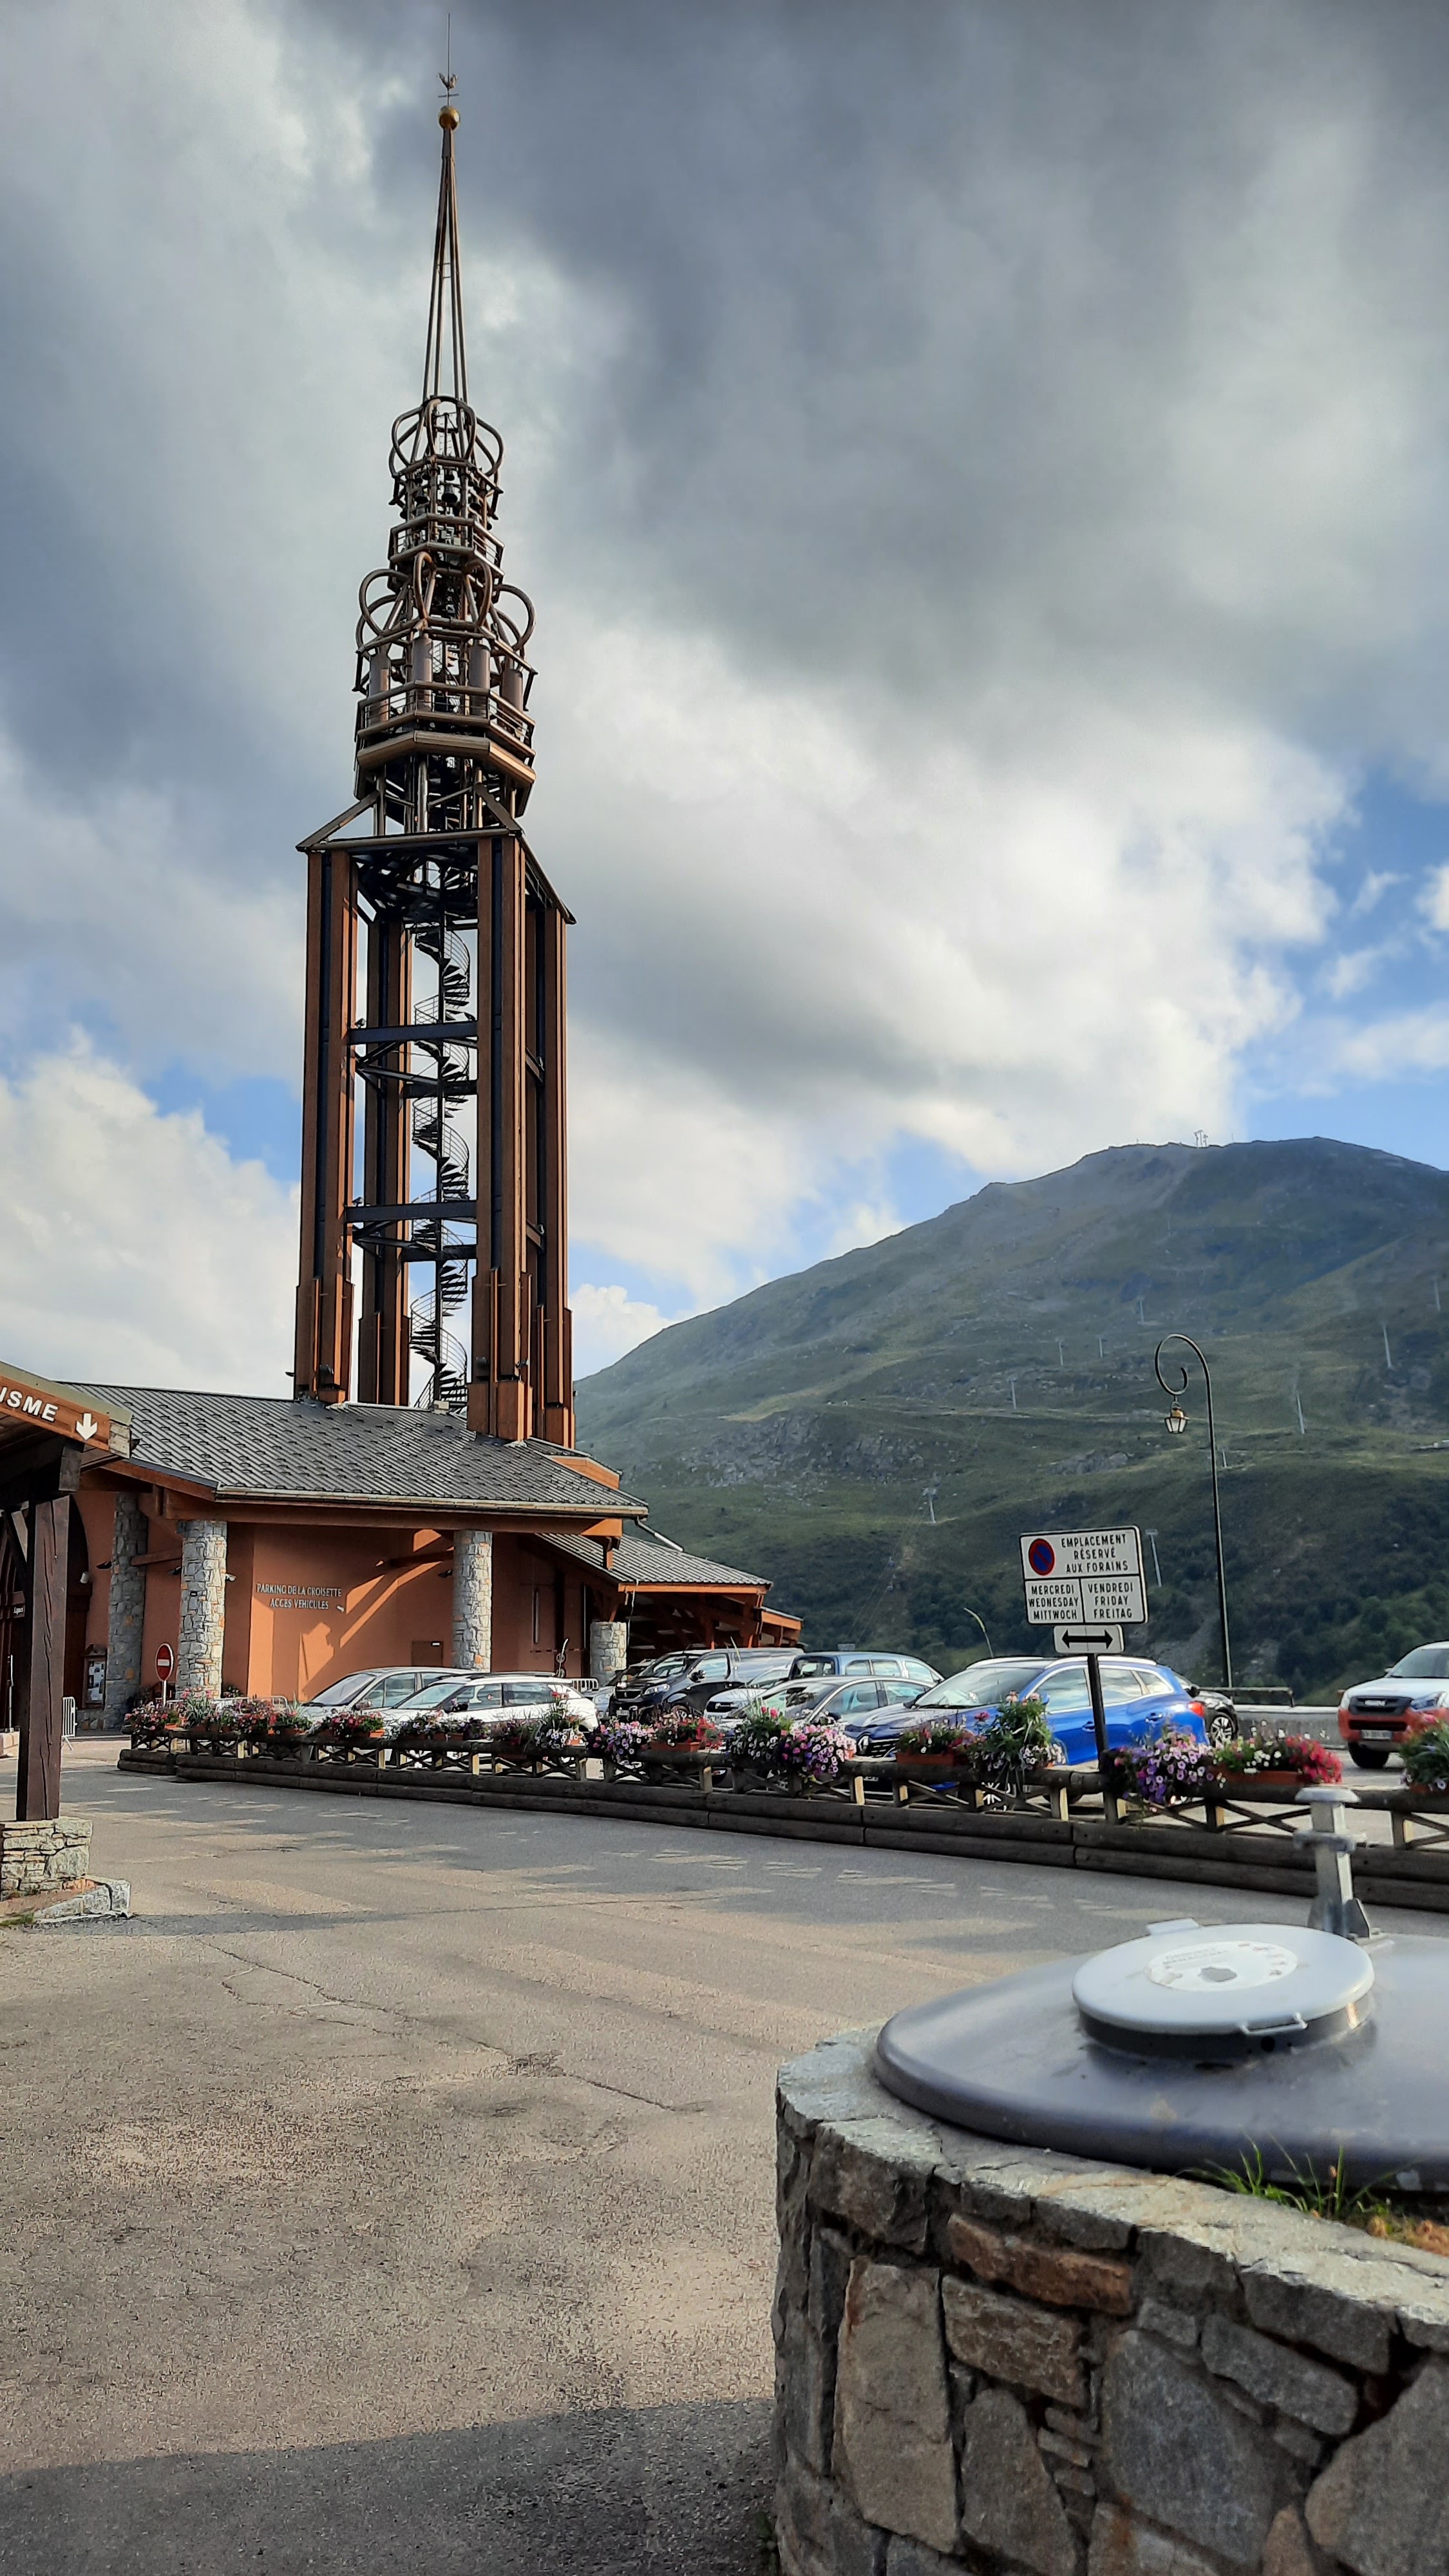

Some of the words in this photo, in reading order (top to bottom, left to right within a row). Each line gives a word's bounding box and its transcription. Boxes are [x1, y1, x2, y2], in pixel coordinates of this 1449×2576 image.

[1061, 1534, 1126, 1548] EMPLACEMENT
[1074, 1548, 1116, 1560] RÉSERVÉ
[1066, 1563, 1083, 1573] AUX
[1086, 1560, 1128, 1573] FORAINS
[257, 1584, 286, 1595] PARKING
[288, 1586, 296, 1595] DE
[298, 1586, 305, 1595] LA
[307, 1587, 341, 1597] CROISETTE
[1031, 1584, 1074, 1595] MERCREDI
[1088, 1582, 1133, 1593] VENDREDI
[270, 1598, 292, 1608] ACCES
[294, 1599, 328, 1609] VEHICULES
[1028, 1596, 1079, 1607] WEDNESDAY
[1095, 1595, 1128, 1606] FRIDAY
[1034, 1609, 1077, 1620] MITTWOCH
[1094, 1608, 1132, 1618] FREITAG
